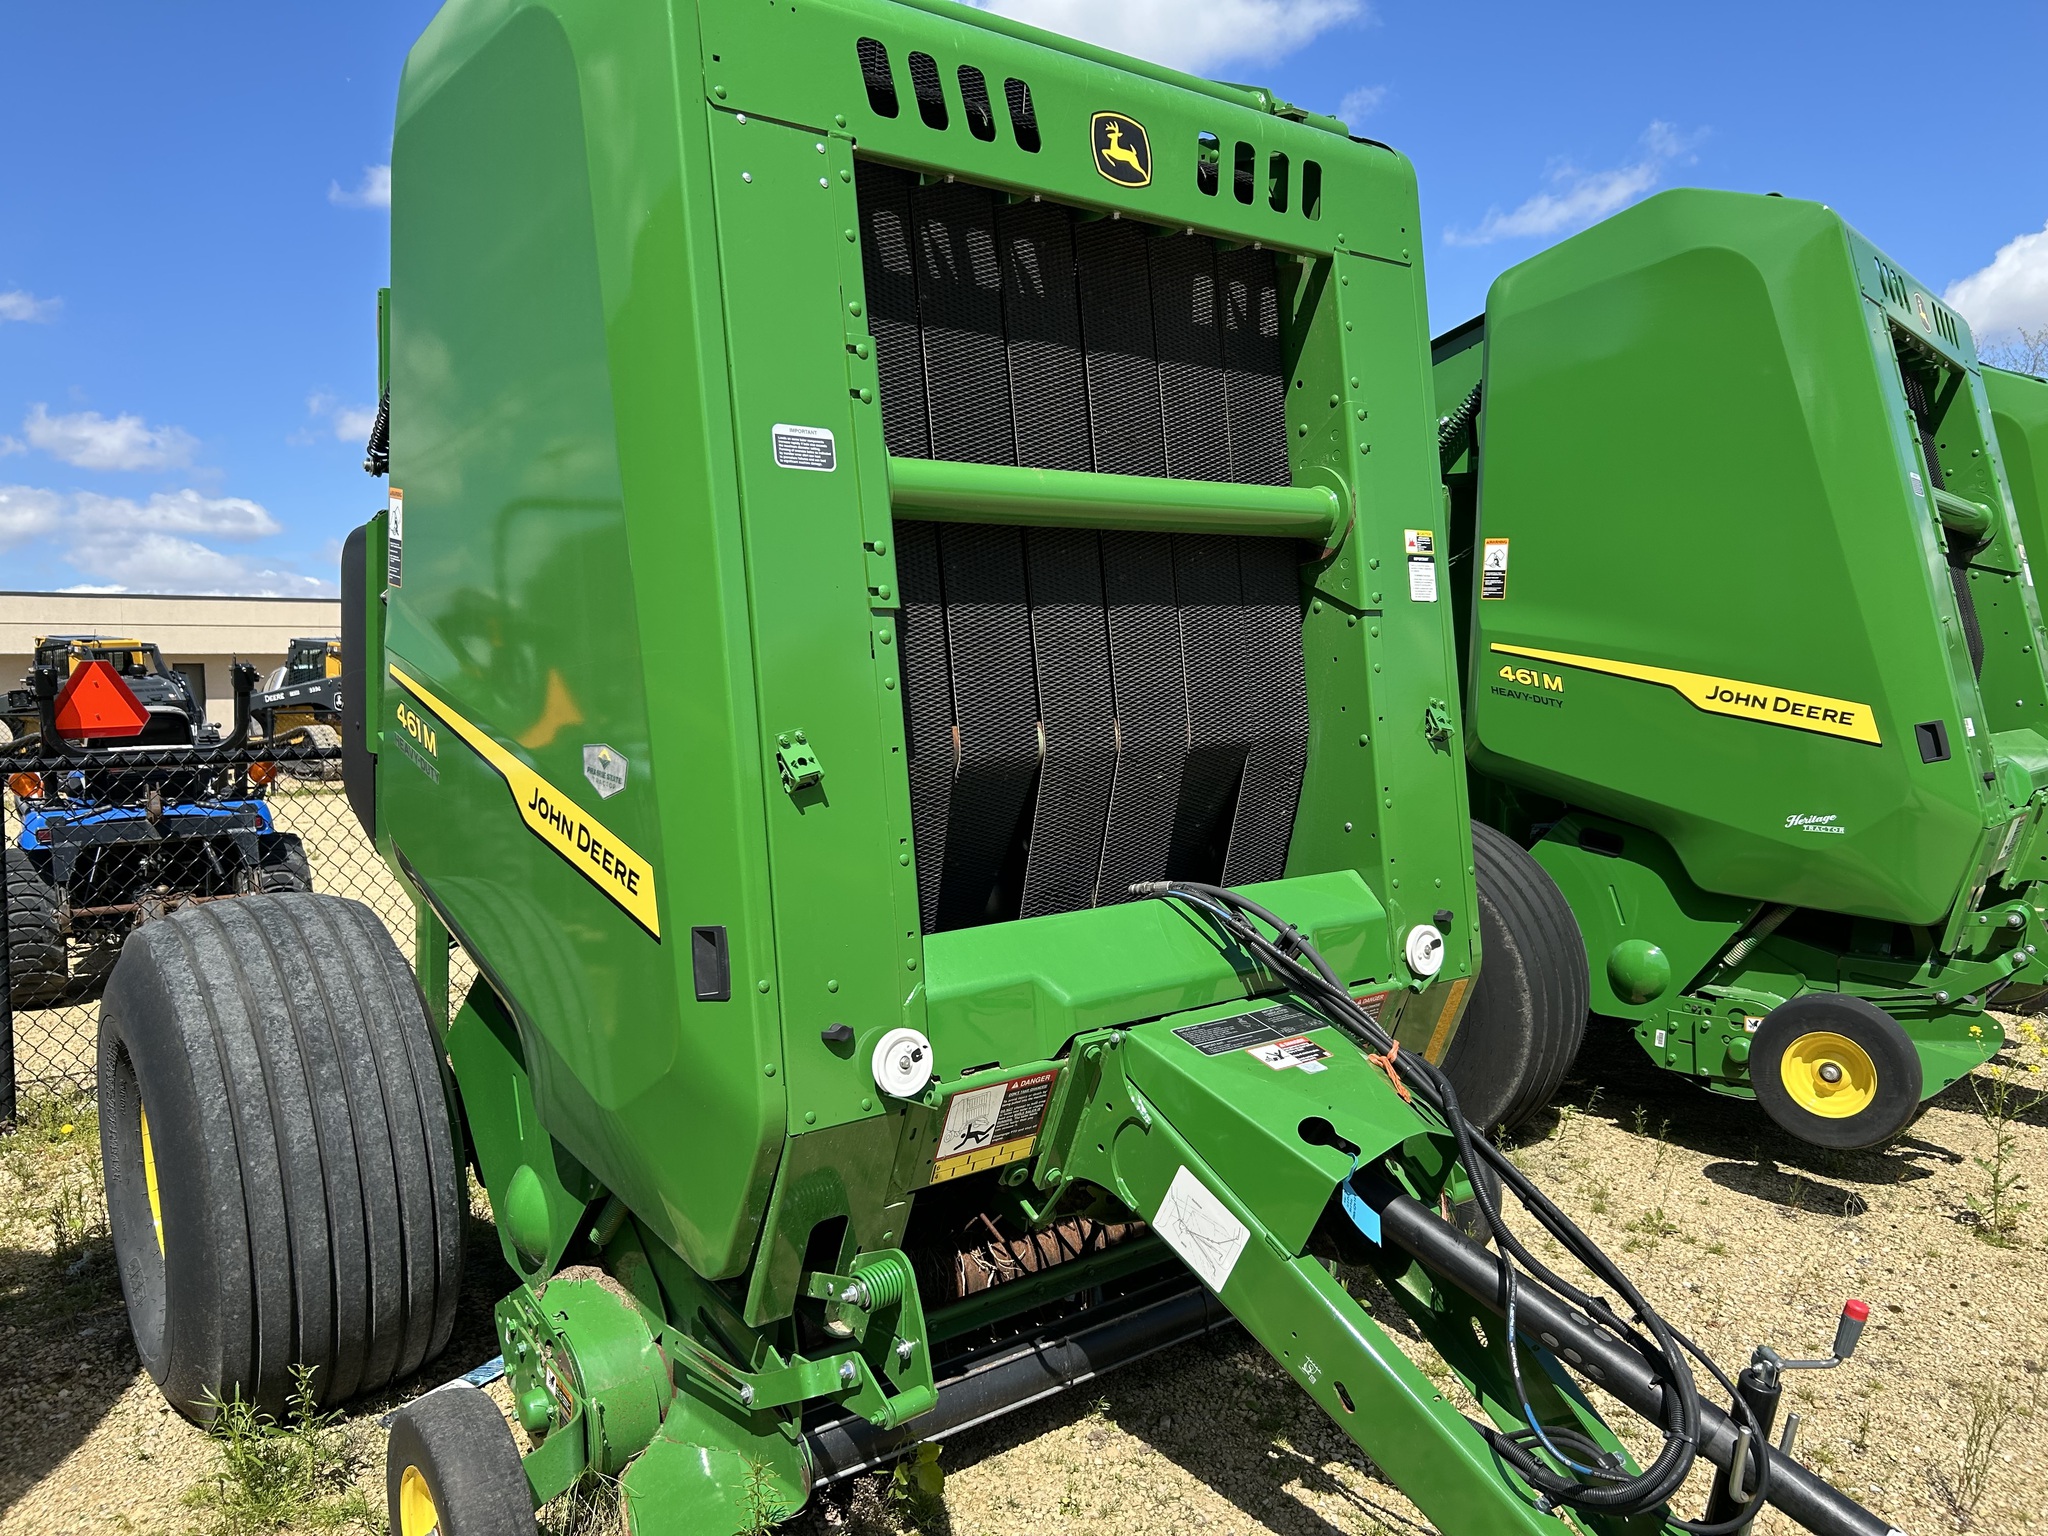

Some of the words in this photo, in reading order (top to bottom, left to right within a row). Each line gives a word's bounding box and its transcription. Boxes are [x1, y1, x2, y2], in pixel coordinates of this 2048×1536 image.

[1499, 665, 1564, 693] 461M
[264, 692, 285, 703] DEERE
[1491, 686, 1563, 708] HEAVY-DUTY
[1706, 686, 1768, 710] JOHN
[1773, 697, 1855, 726] DEERE
[397, 702, 438, 759] 461M
[606, 773, 622, 784] STATE
[1784, 813, 1837, 828] Heritage
[1803, 825, 1844, 834] TRACTOR
[528, 787, 574, 842] JOHN
[577, 822, 640, 896] DEERE
[1362, 995, 1385, 1004] DANGER
[1020, 1074, 1051, 1087] DANGER
